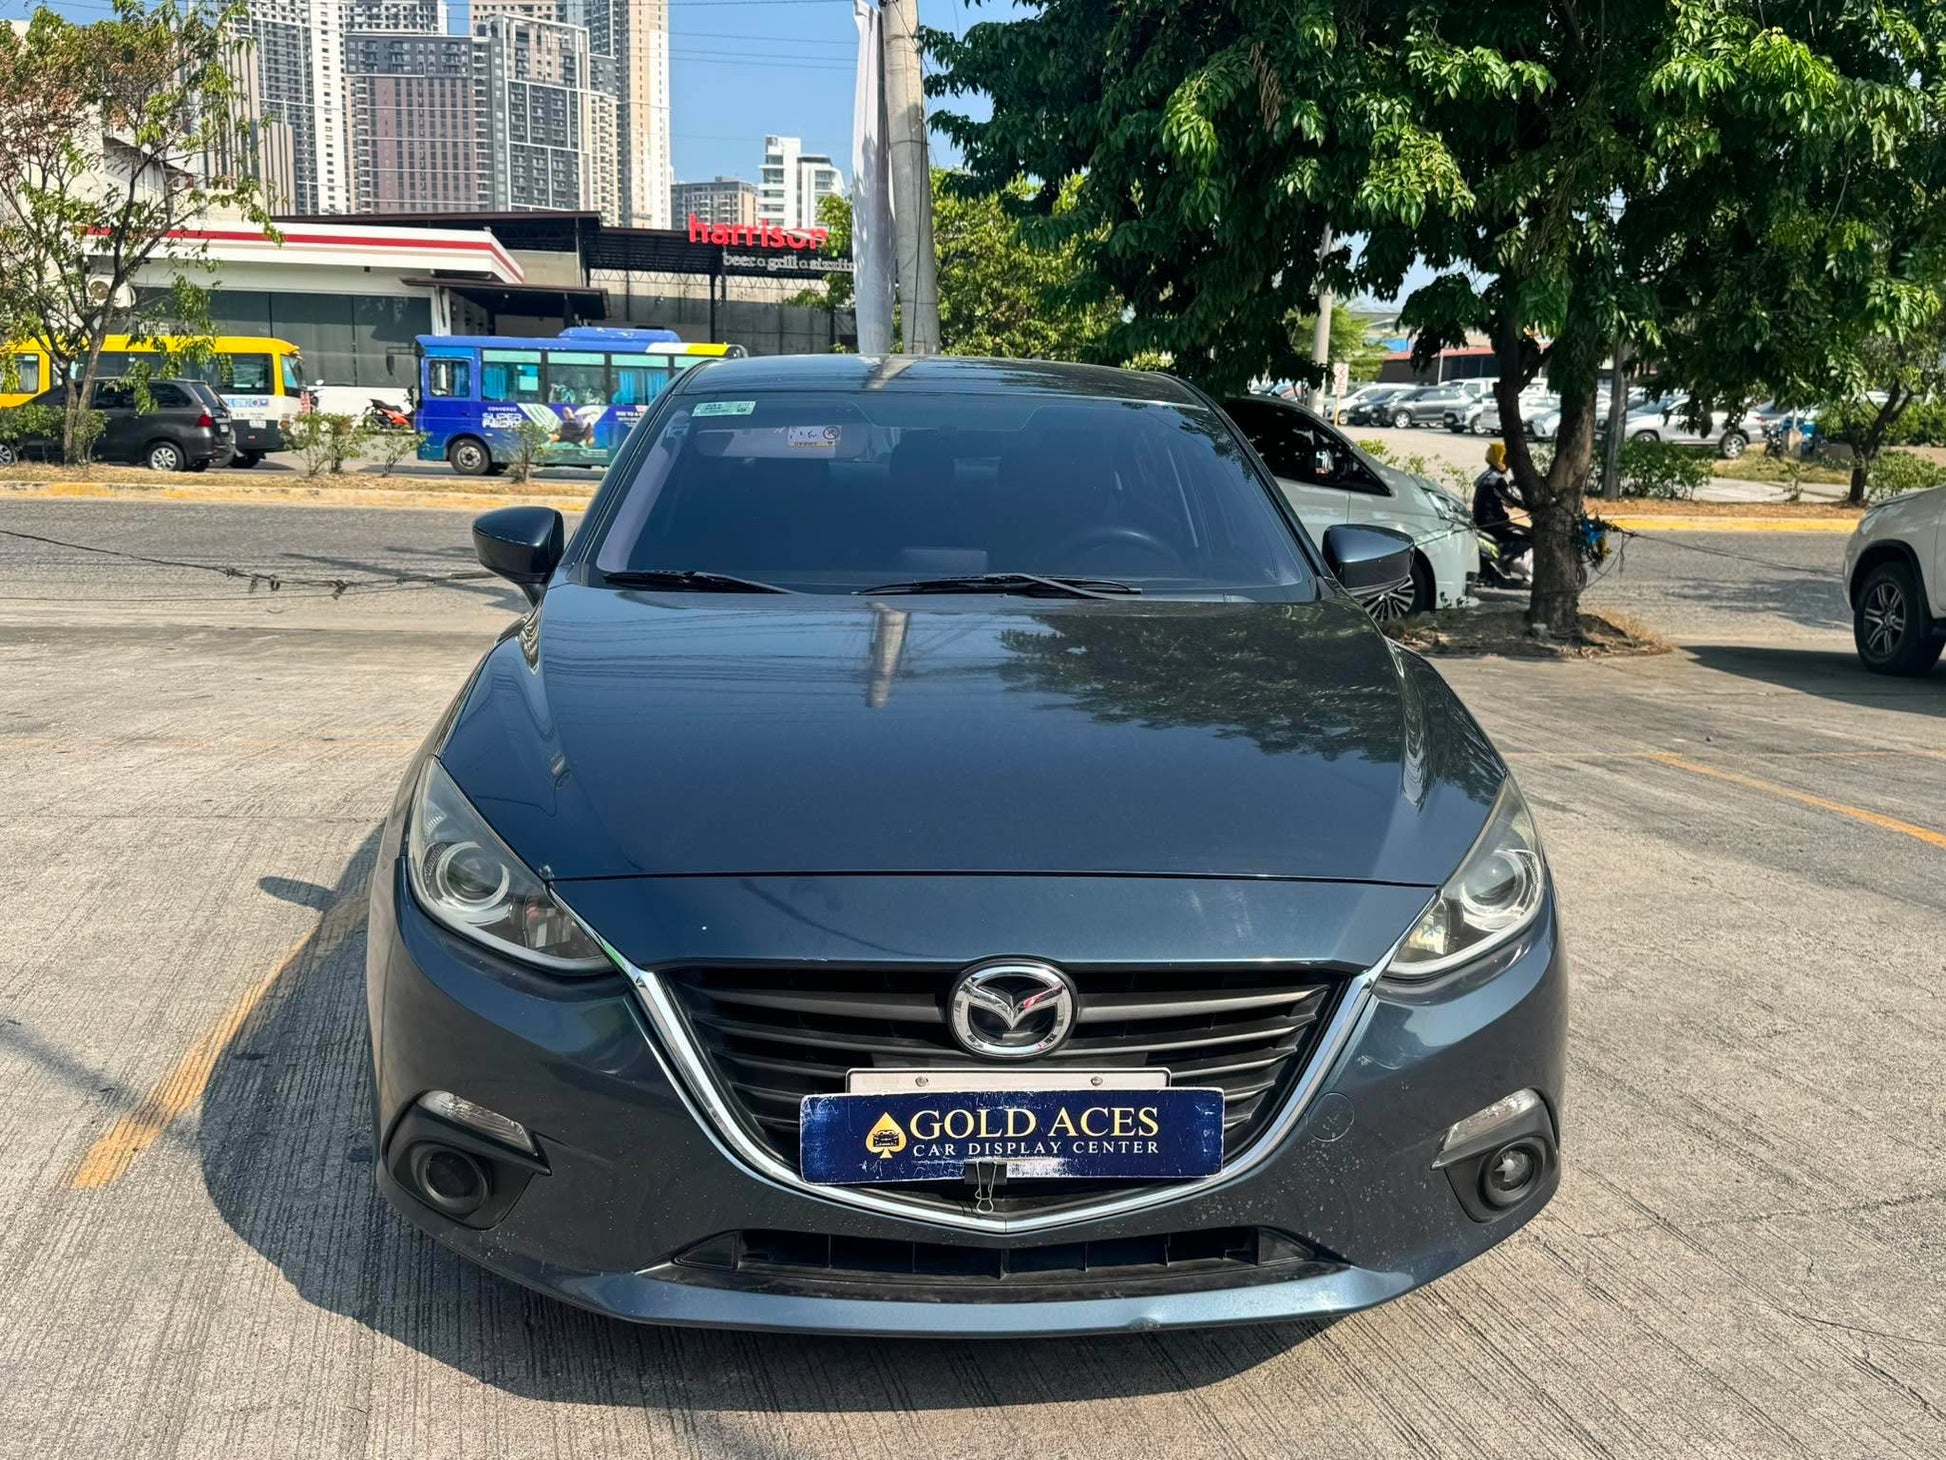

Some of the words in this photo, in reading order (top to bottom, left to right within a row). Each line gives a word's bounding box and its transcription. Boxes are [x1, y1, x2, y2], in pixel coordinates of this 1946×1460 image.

[722, 251, 756, 267] beer
[767, 254, 798, 271] grill
[809, 257, 854, 272] sizzlin
[482, 412, 522, 422] SUPER
[910, 1108, 1037, 1139] GOLD
[1047, 1106, 1159, 1137] ACES
[913, 1143, 956, 1157] CAR
[968, 1141, 1062, 1155] DISPLAY
[1073, 1141, 1159, 1154] CENTER
